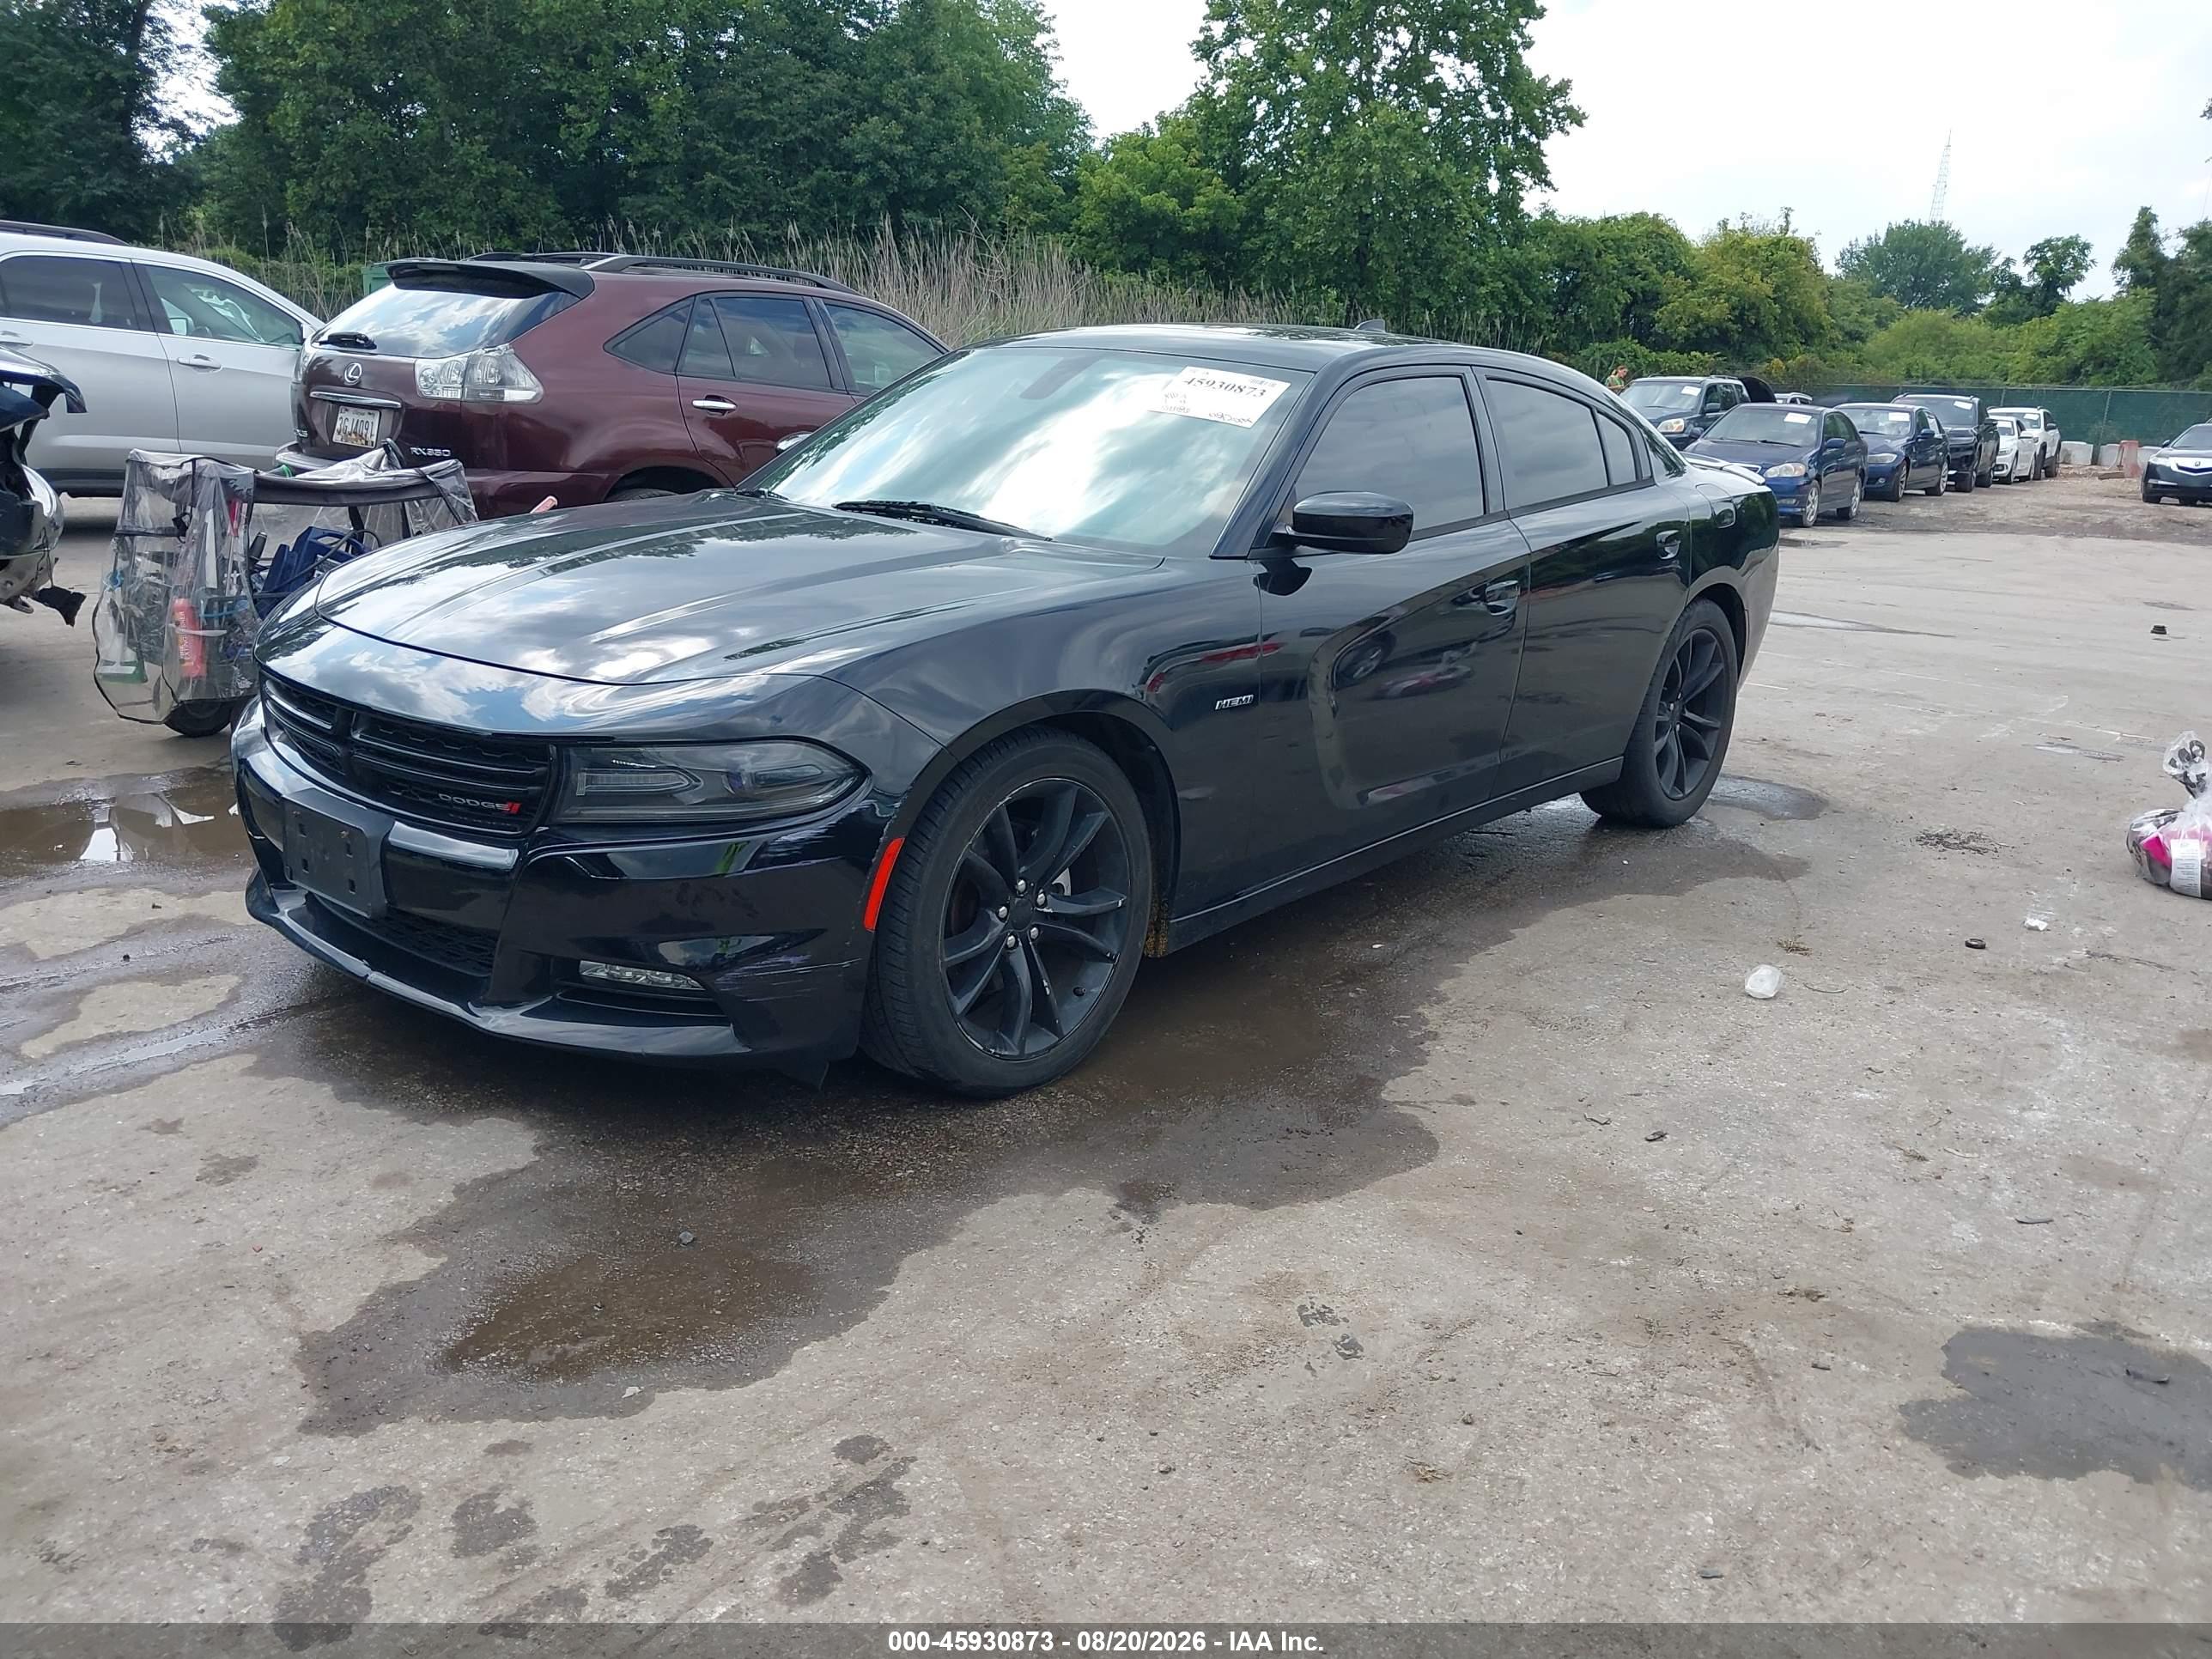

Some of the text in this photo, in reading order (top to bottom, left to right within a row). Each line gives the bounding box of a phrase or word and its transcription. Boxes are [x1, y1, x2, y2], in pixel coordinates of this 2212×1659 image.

[1182, 375, 1267, 398] 45930873
[337, 416, 375, 439] 3GJ4091
[1214, 694, 1254, 710] HEMI
[438, 793, 510, 811] DODGE
